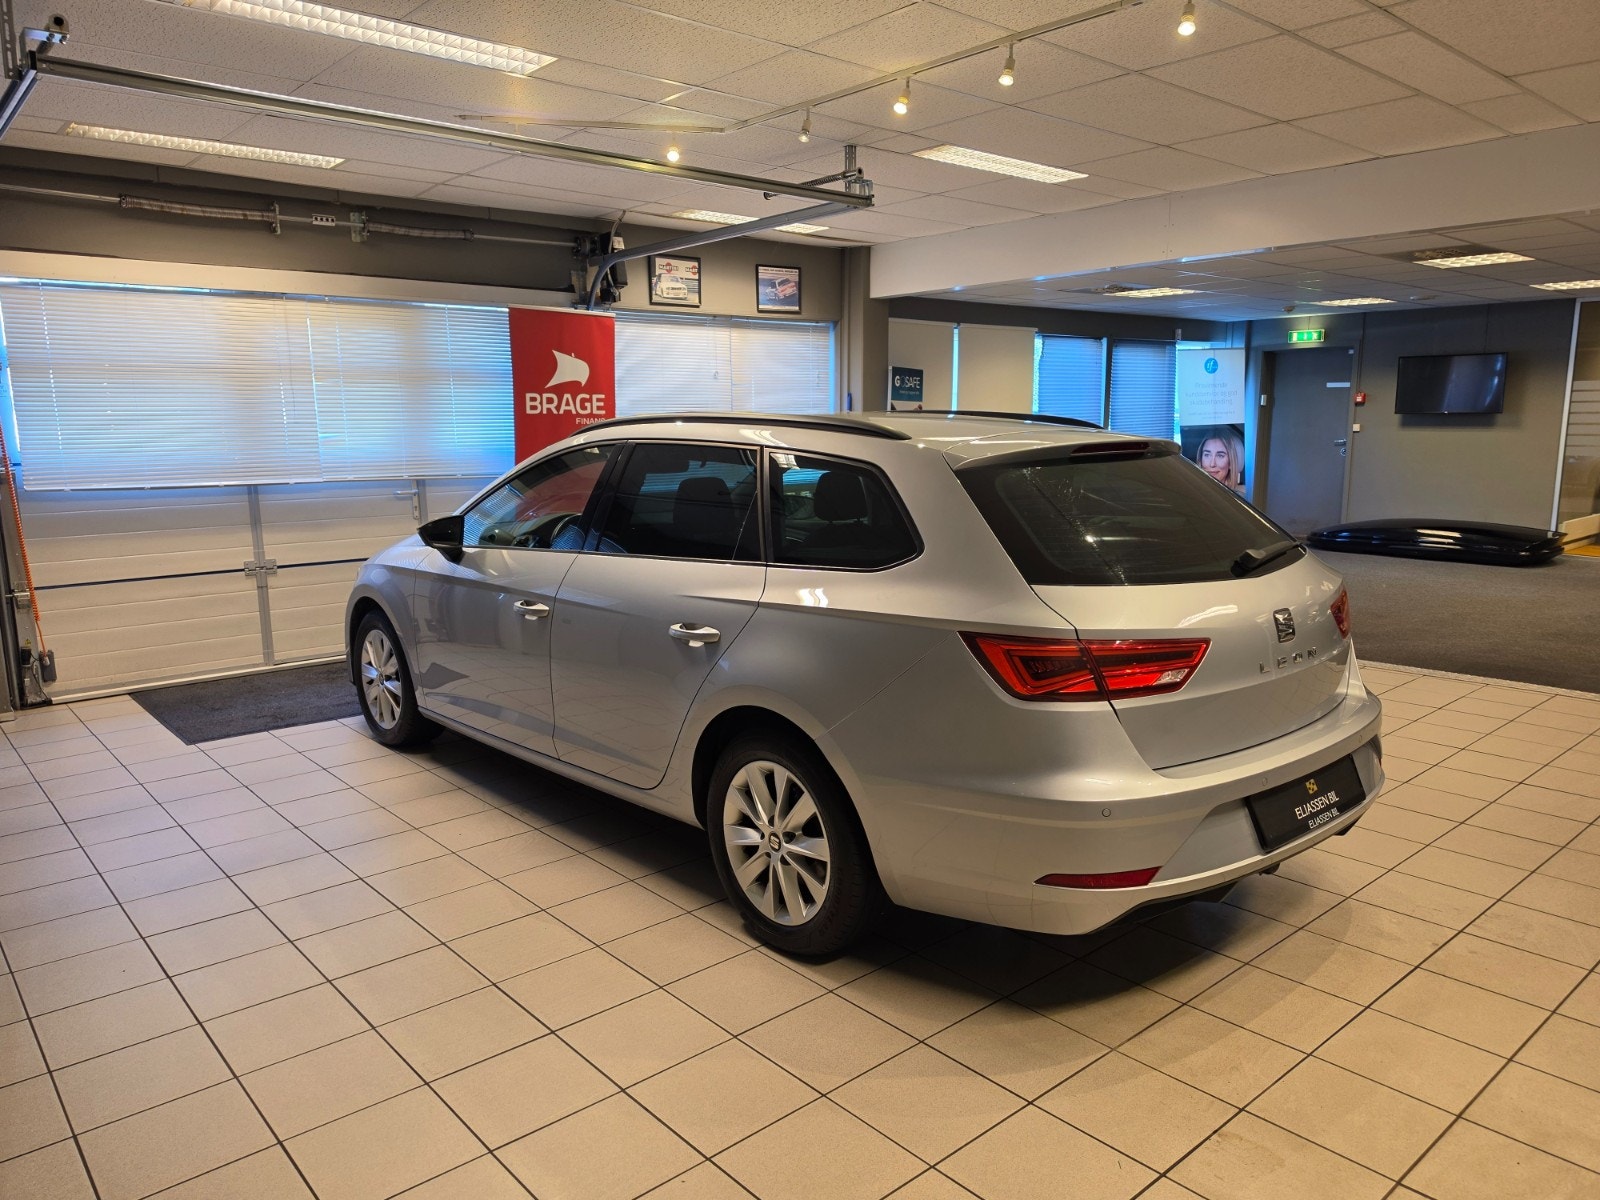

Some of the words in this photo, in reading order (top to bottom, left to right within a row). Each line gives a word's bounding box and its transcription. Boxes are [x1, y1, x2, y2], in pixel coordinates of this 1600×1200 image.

[525, 393, 606, 414] BRAGE
[1260, 647, 1317, 673] LEON
[1295, 794, 1330, 819] ELIASSEN
[1327, 790, 1340, 803] BIL
[1308, 811, 1333, 828] ELIASSEN
